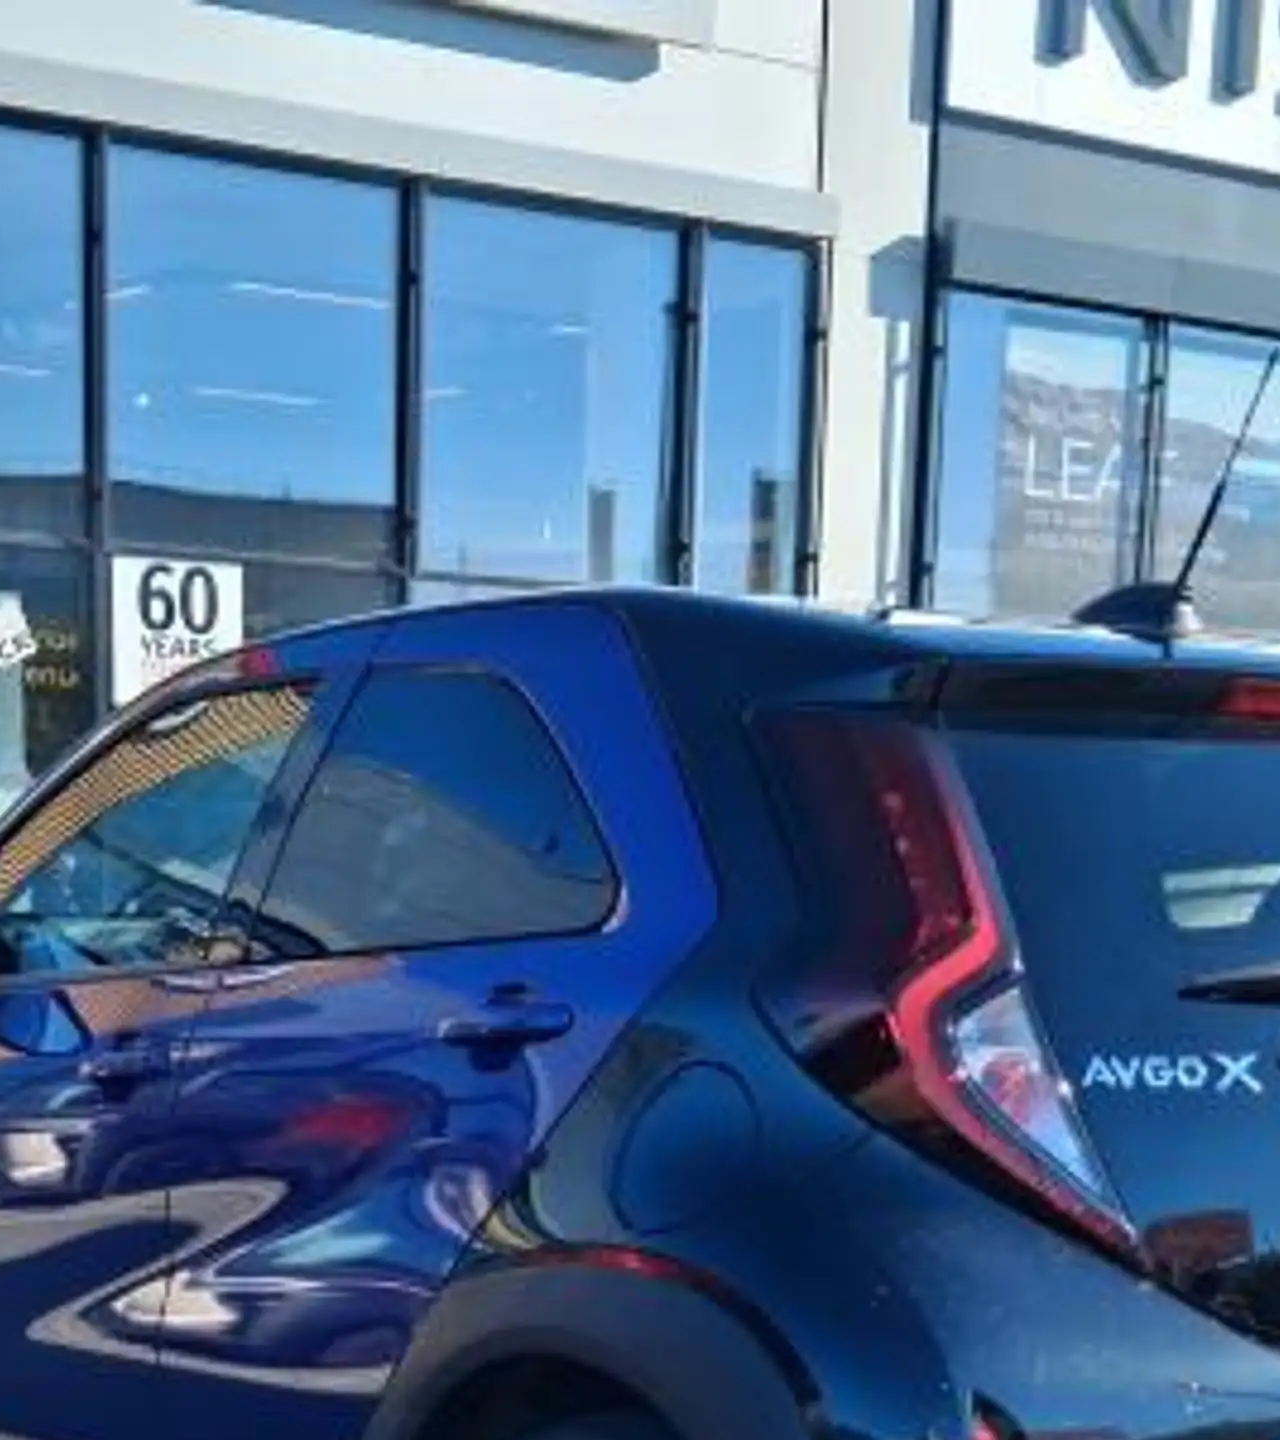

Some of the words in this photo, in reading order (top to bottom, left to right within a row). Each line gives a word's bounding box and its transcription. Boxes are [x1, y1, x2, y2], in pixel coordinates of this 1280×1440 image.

[138, 562, 218, 635] 60
[140, 634, 220, 661] YEARS
[1210, 1050, 1264, 1096] X
